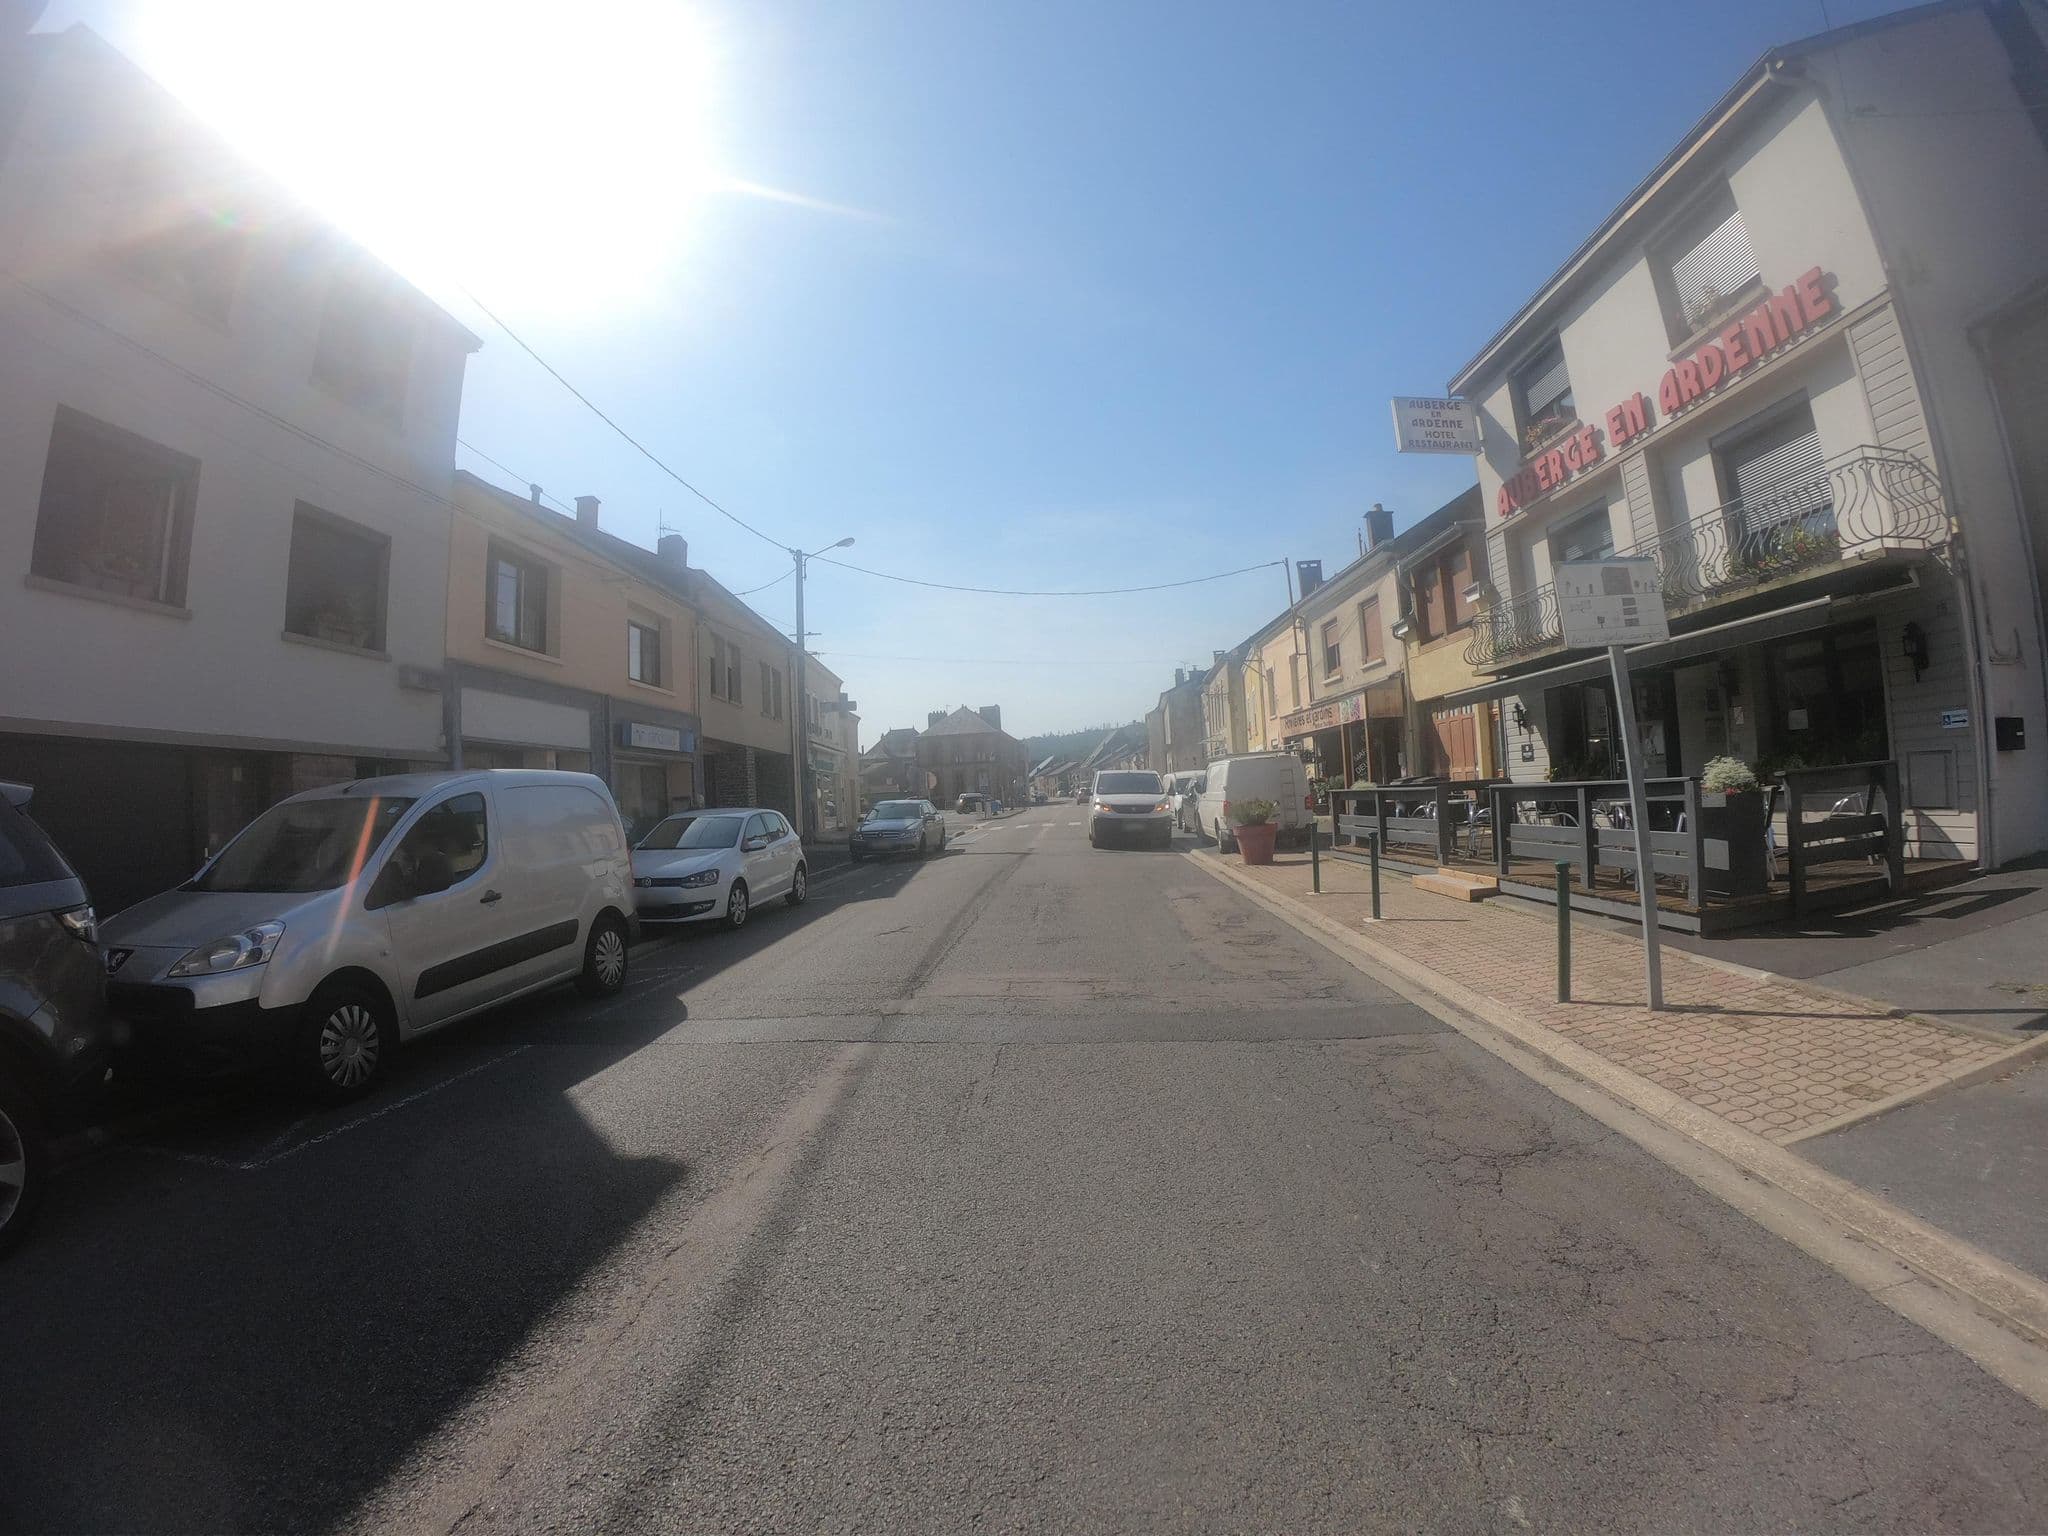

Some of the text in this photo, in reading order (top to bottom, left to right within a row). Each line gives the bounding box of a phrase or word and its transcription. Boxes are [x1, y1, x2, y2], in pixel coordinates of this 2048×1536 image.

[1497, 266, 1834, 518] AUBERGE EN ARDENNE
[1409, 400, 1461, 411] AUBERGE
[1411, 418, 1464, 429] ARDENNE
[1425, 431, 1457, 439] HOTEL
[1408, 440, 1473, 449] RESTAURANT
